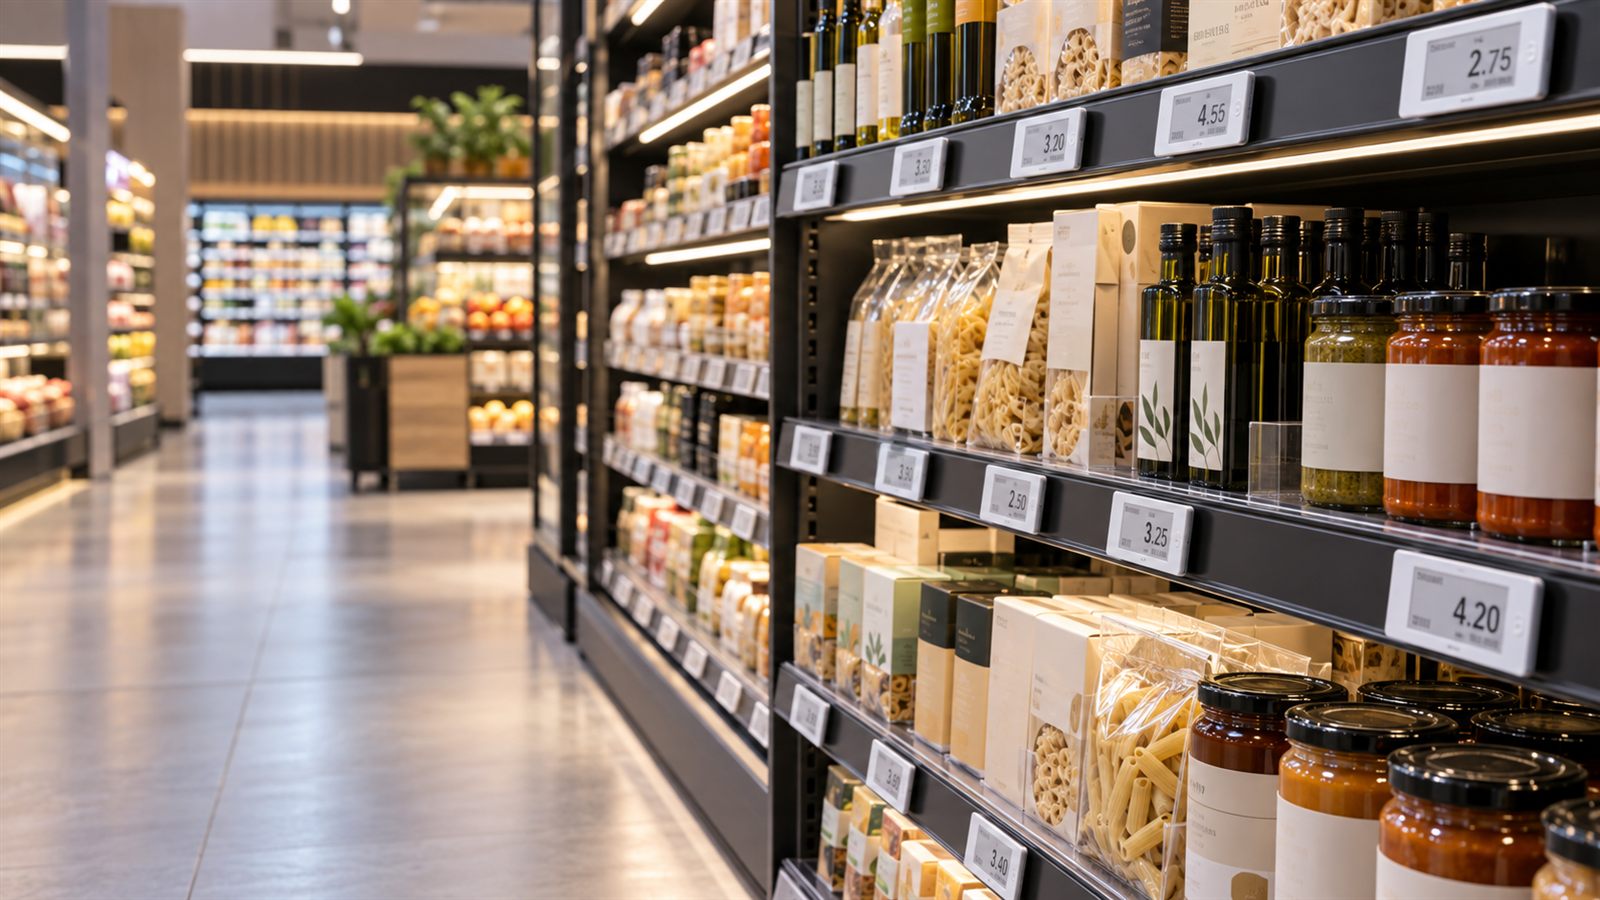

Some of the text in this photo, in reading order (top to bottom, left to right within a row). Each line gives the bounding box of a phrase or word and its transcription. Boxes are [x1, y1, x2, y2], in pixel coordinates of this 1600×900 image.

[1467, 45, 1512, 78] 2.75
[1197, 103, 1226, 126] 4.55
[1043, 133, 1065, 154] 3.20
[1008, 489, 1027, 511] 2.50
[1144, 521, 1168, 548] 3.25
[1453, 596, 1500, 634] 4.20
[990, 848, 1009, 876] 3.40
